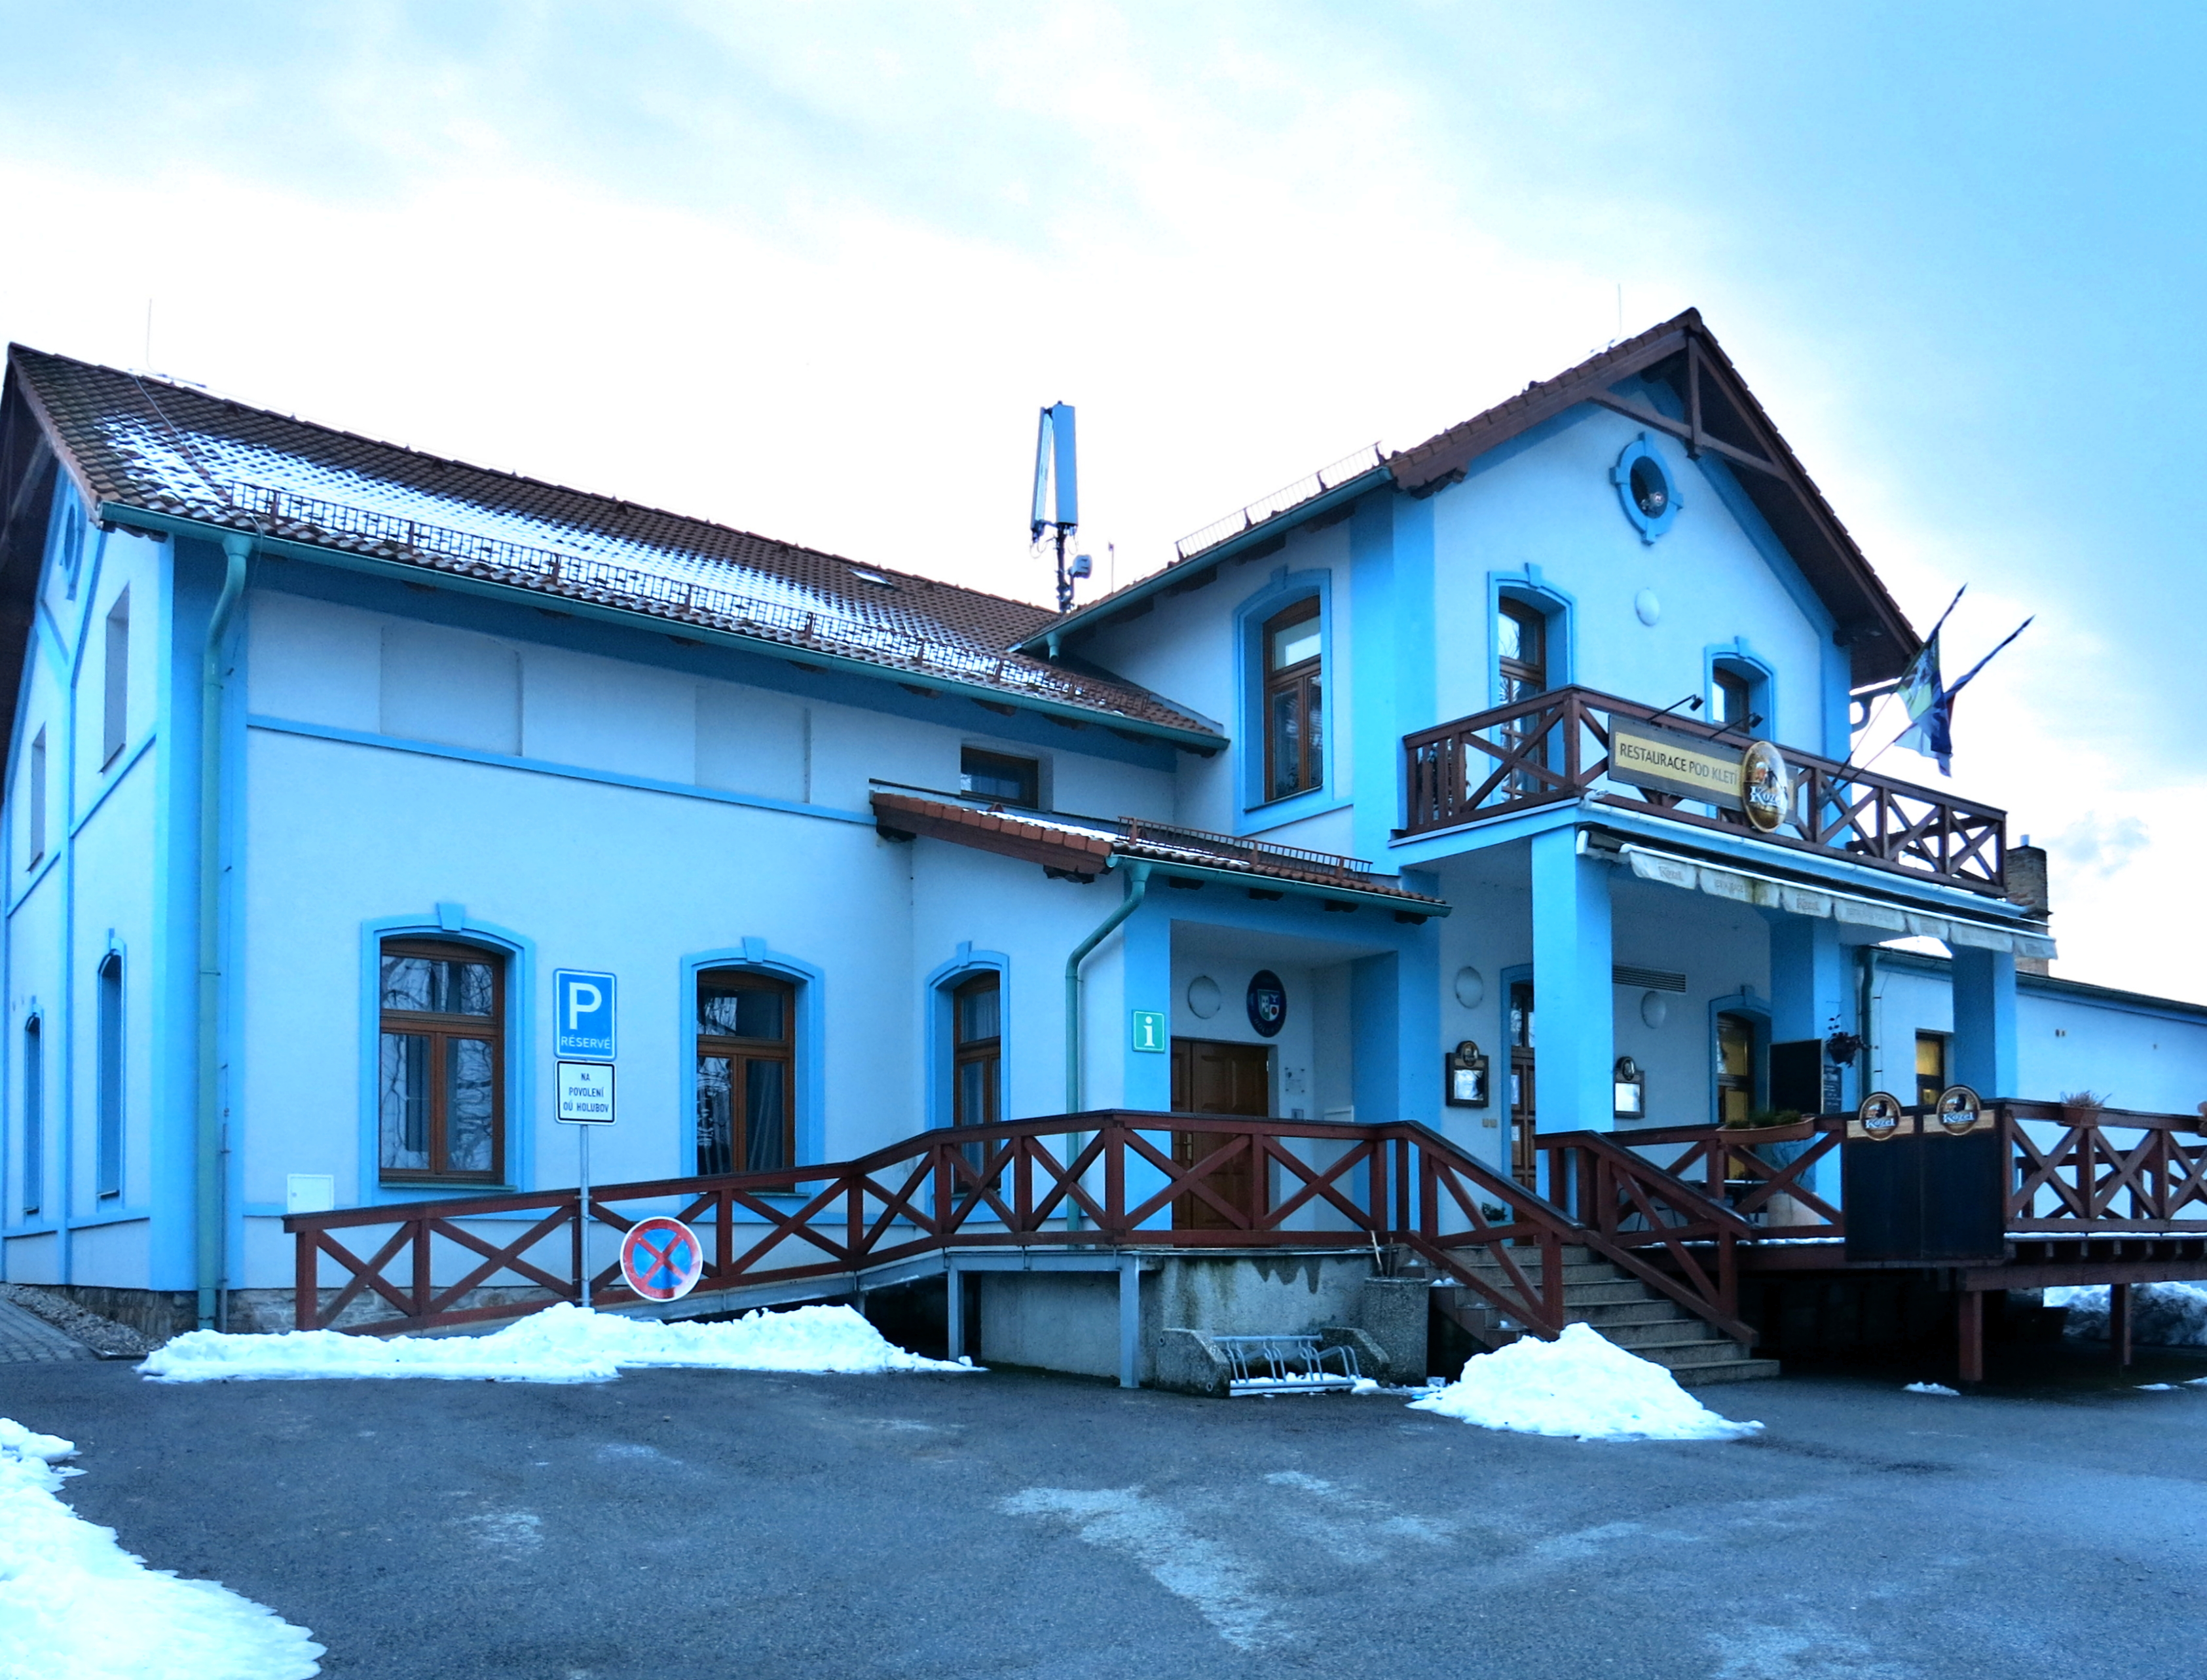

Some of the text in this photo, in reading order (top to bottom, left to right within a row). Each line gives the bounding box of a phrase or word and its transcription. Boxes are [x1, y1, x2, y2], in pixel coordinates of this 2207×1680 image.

[1620, 742, 1687, 772] RESTAURACE
[1689, 761, 1709, 778] POD
[569, 982, 602, 1030] P
[561, 1035, 611, 1049] RÉSERVÉ
[581, 1073, 590, 1081] NA
[568, 1087, 604, 1098] POVOLENÍ
[563, 1100, 610, 1113] OÚ HOLUBOV
[1865, 1117, 1896, 1129] Kozel
[1942, 1111, 1975, 1124] Kozel
